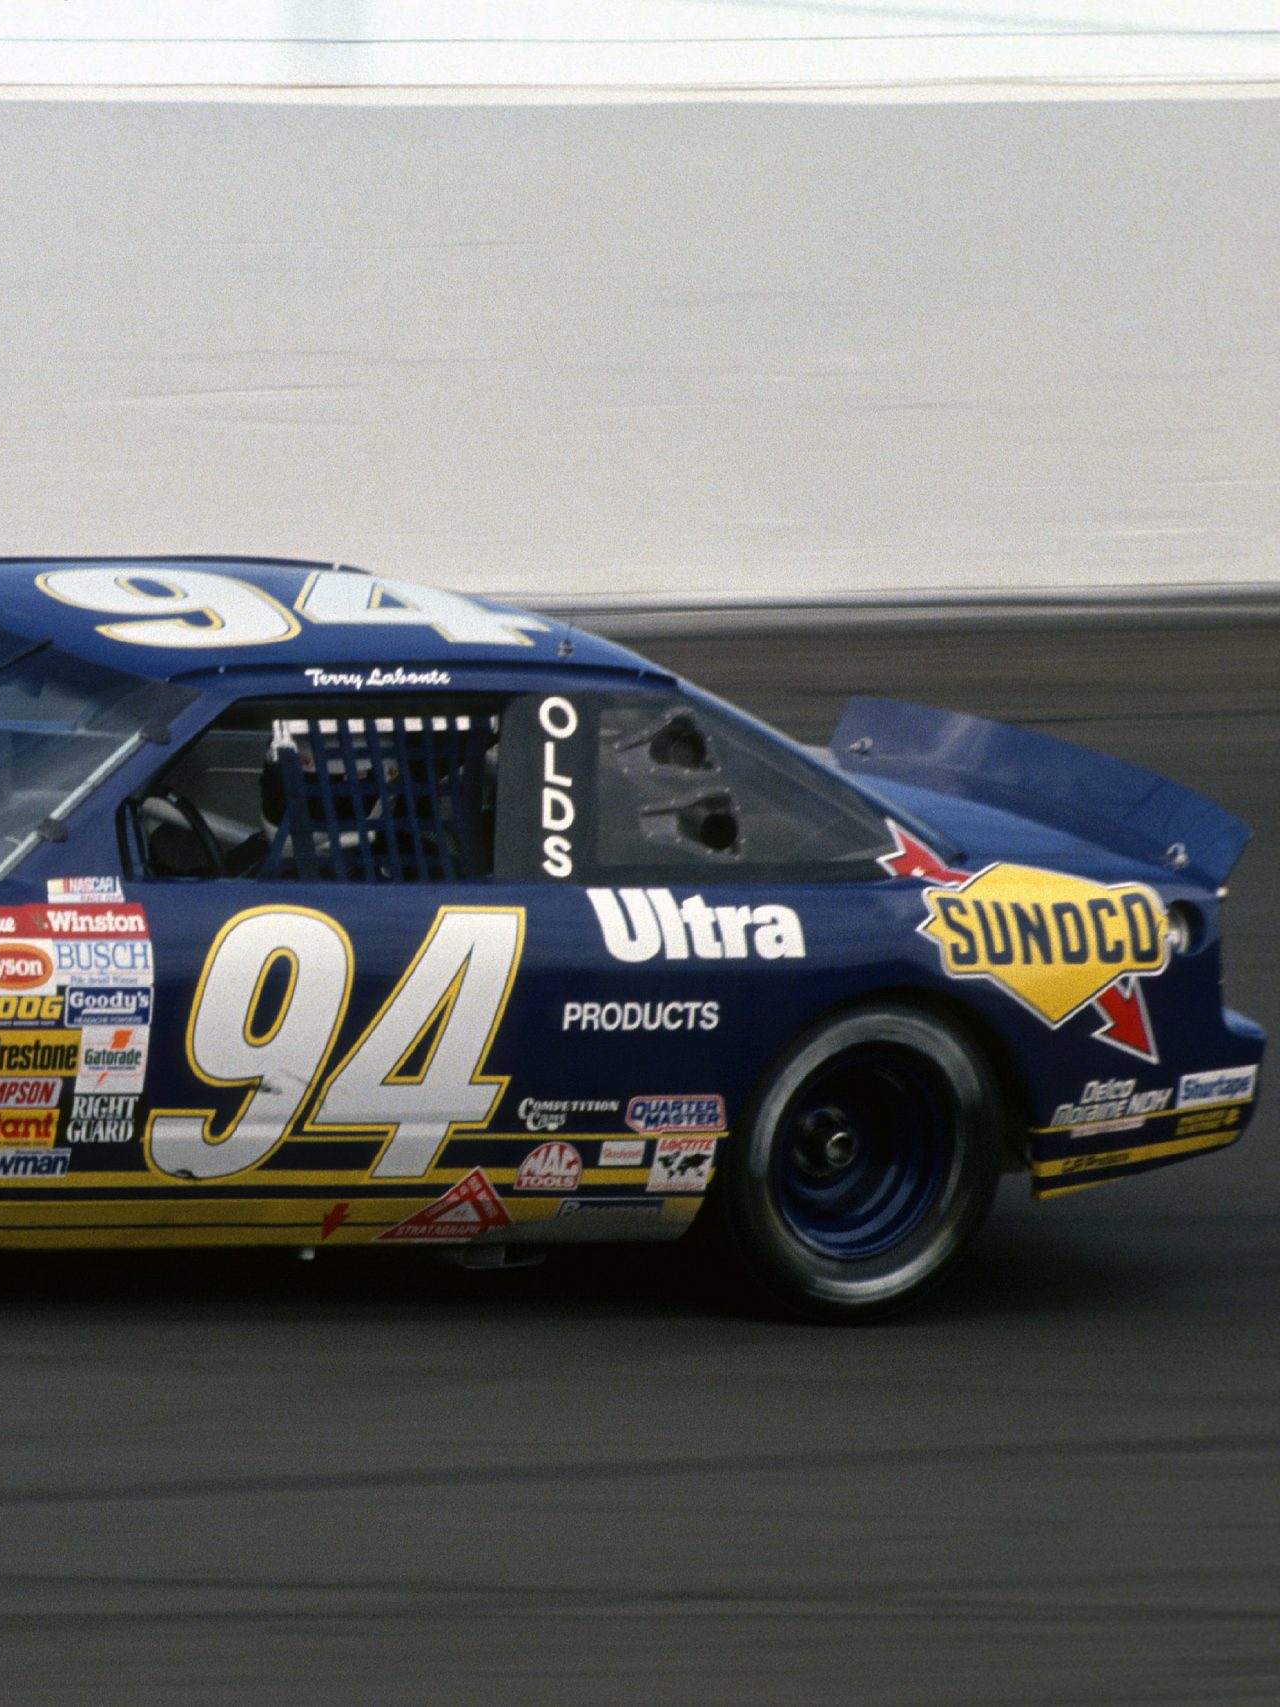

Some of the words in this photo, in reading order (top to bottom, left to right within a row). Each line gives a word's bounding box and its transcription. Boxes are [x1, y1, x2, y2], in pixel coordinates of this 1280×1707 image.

[34, 567, 551, 648] 94
[304, 668, 363, 690] Terry
[366, 666, 452, 686] Labonte
[538, 696, 578, 878] OLDS
[47, 909, 146, 932] Winston
[586, 888, 806, 963] Ultra
[934, 892, 1161, 967] SUNOCO
[56, 941, 151, 971] BUSCH
[69, 990, 150, 1011] Goody's
[562, 1002, 720, 1032] PRODUCTS
[144, 904, 526, 1183] 94
[83, 1047, 142, 1066] Gatorade
[1079, 1078, 1137, 1104] Delco
[71, 1094, 139, 1119] RIGHT
[631, 1100, 718, 1118] QUARTER
[67, 1118, 135, 1143] GUARD
[645, 1112, 719, 1129] MASTER
[521, 1176, 577, 1188] TOOLS
